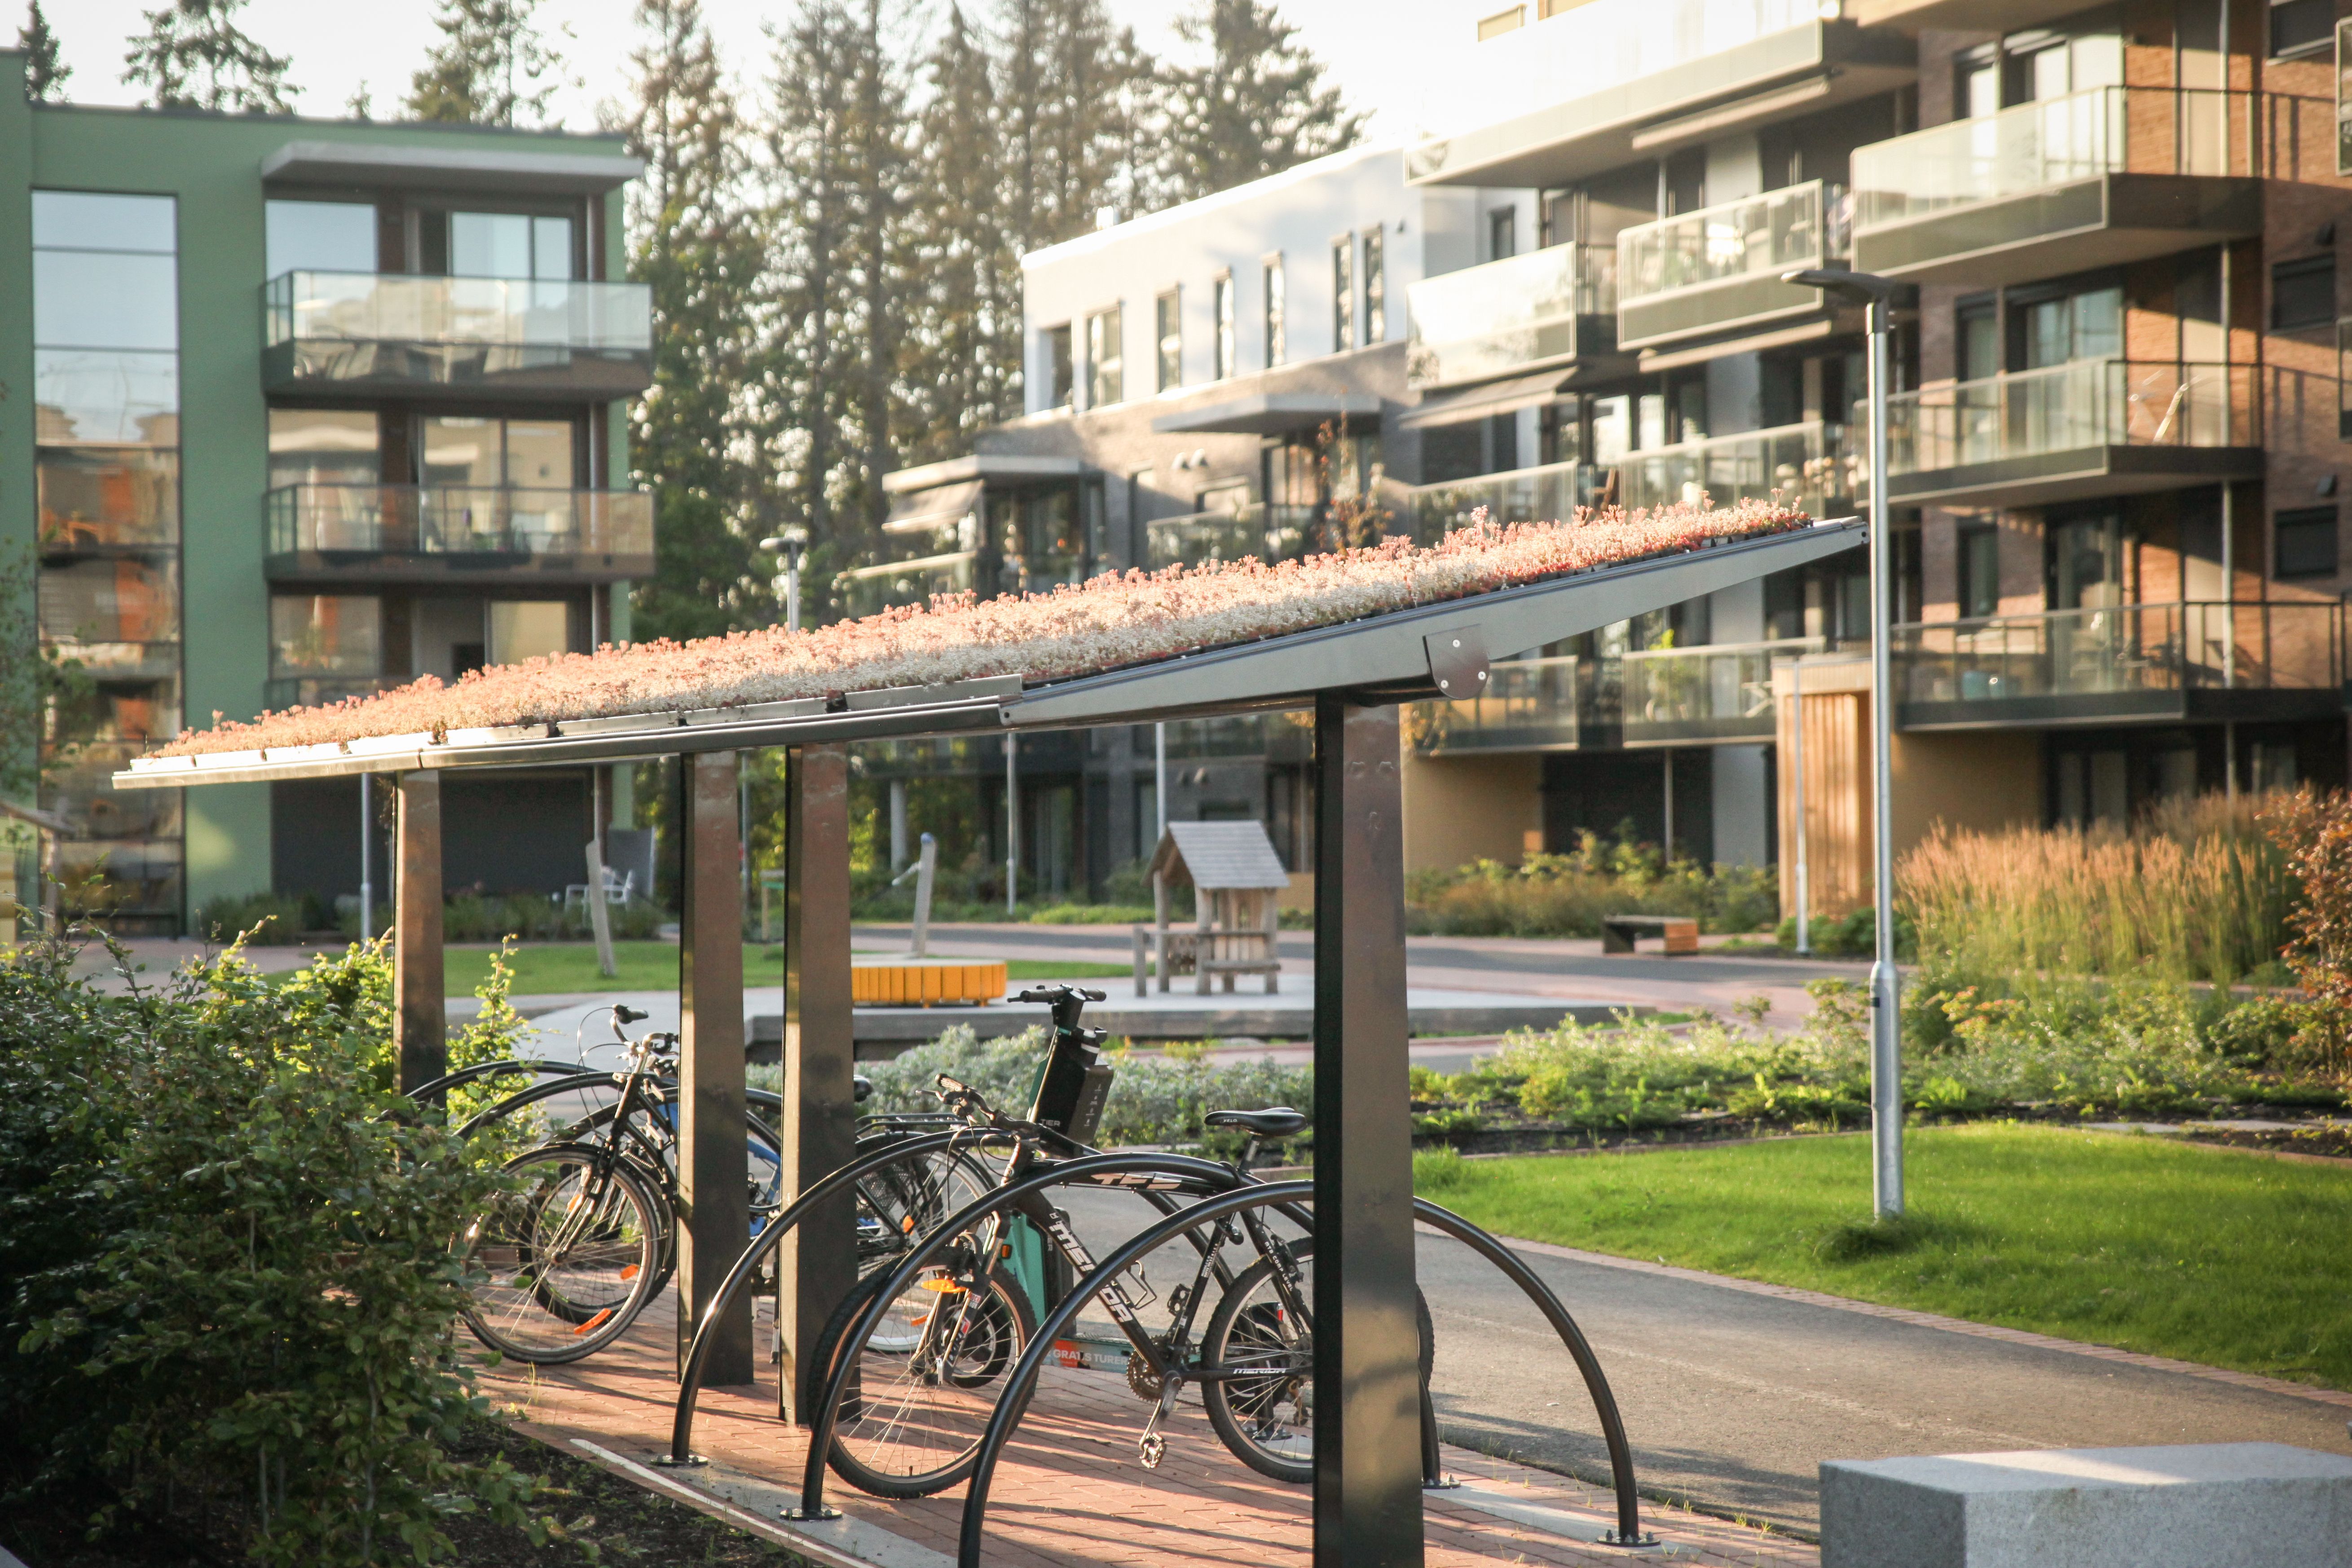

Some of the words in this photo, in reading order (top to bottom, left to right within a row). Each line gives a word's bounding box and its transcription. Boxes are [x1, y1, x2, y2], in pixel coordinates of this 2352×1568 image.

[1040, 1119, 1061, 1127] TIER
[1048, 1220, 1133, 1323] MEDA
[1264, 1241, 1274, 1254] MTB
[1272, 1255, 1284, 1272] COMP
[1282, 1273, 1294, 1291] LEVEL
[1053, 1349, 1092, 1361] GRATS
